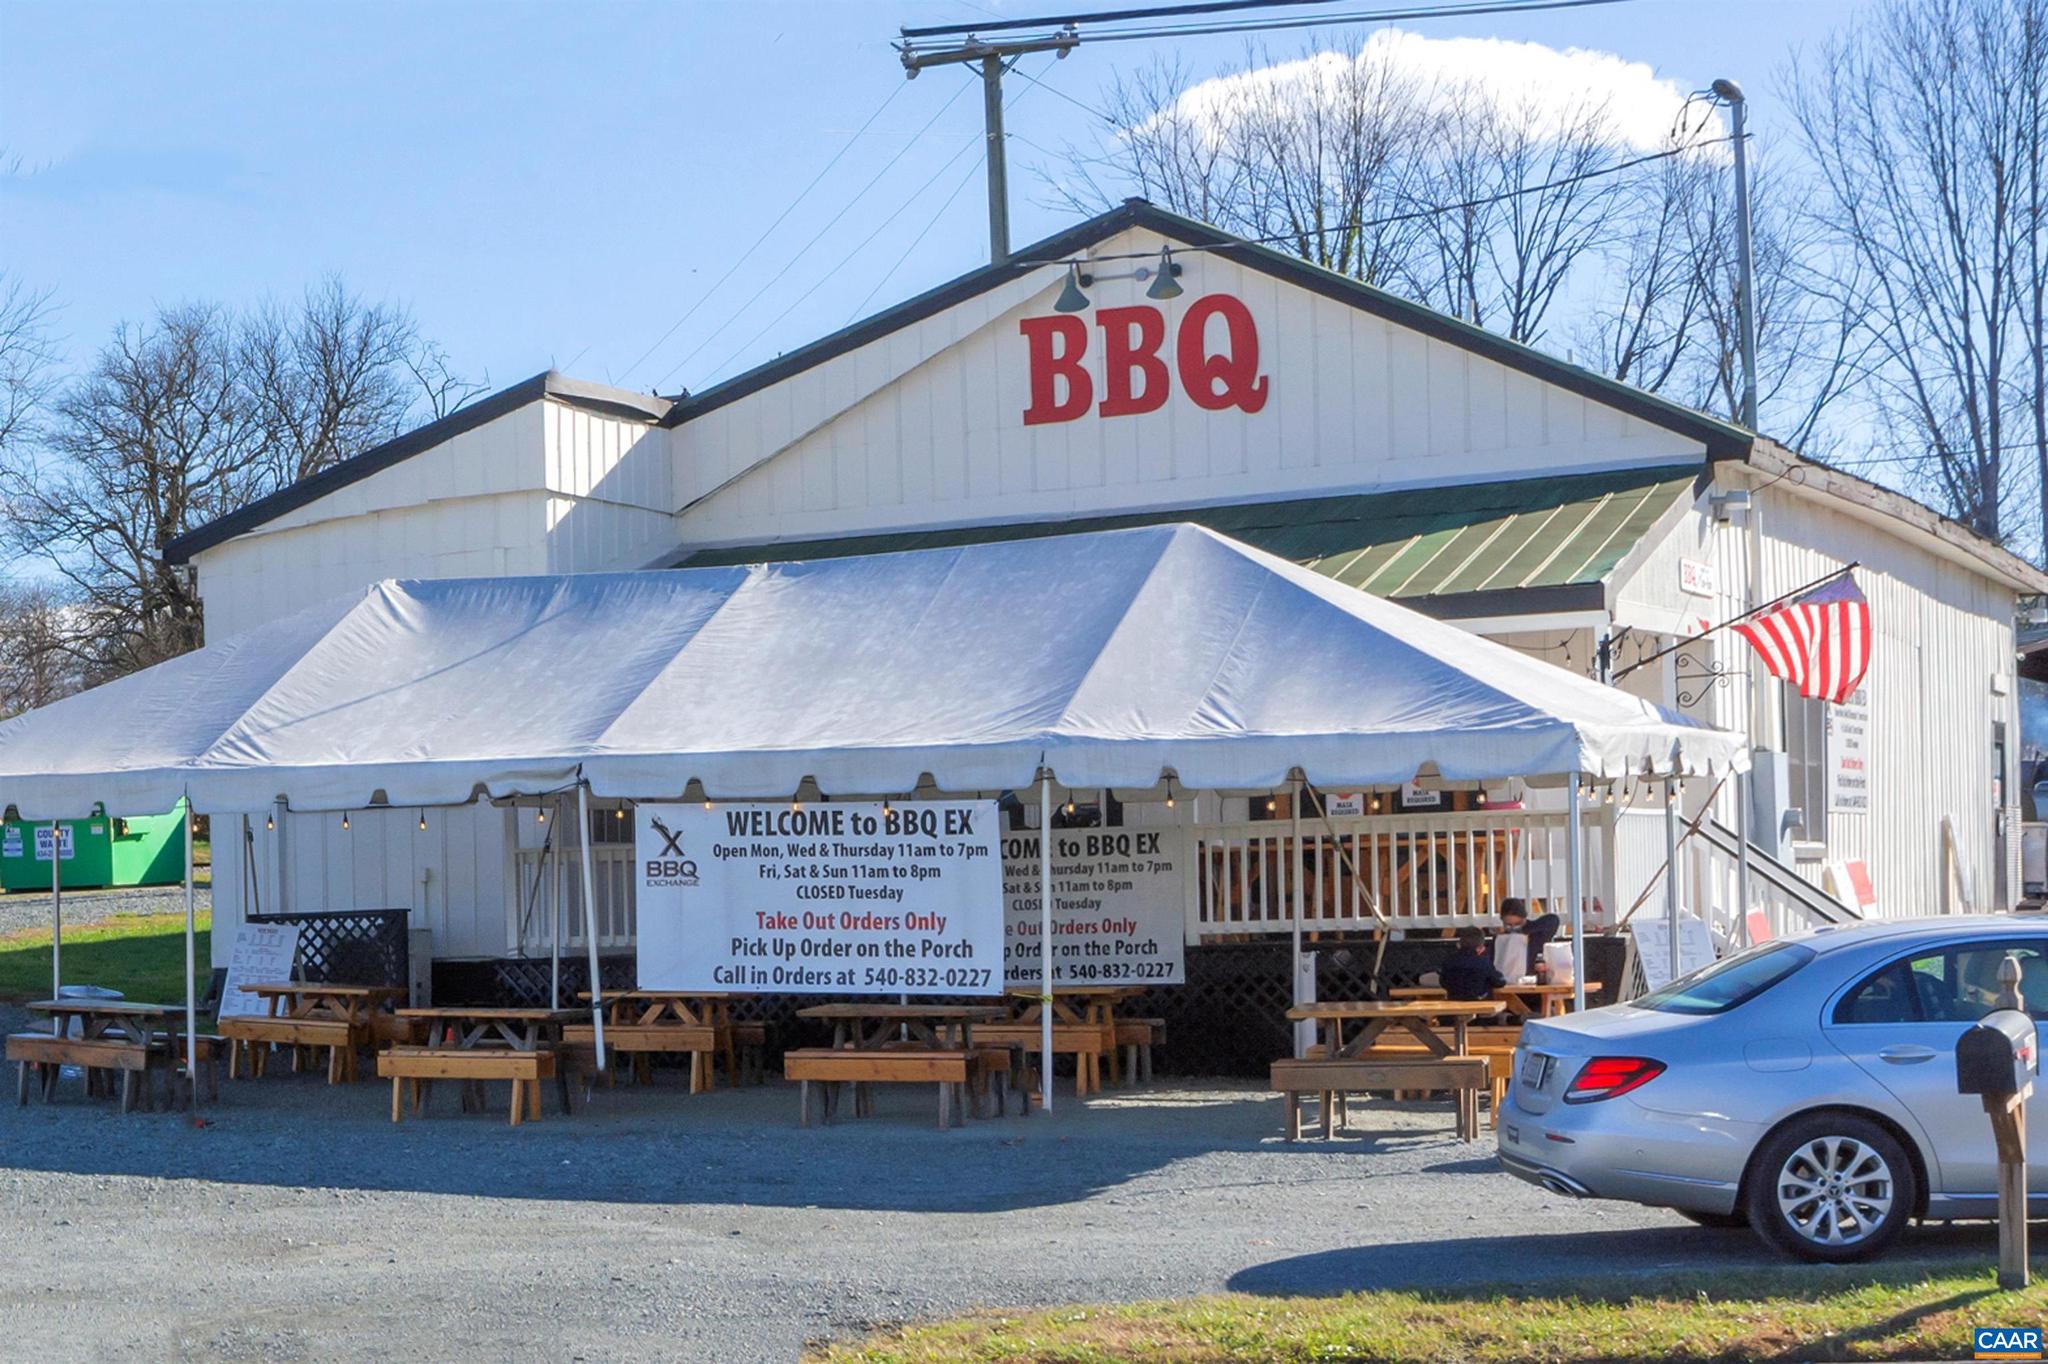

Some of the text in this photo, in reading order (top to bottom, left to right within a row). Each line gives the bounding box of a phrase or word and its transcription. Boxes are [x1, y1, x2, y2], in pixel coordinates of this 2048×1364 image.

[1019, 293, 1269, 426] BBQ
[726, 809, 974, 839] WELCOME to BBQ EX
[37, 829, 70, 839] COUTY
[713, 843, 989, 861] Open Mon, Wed & Thursday 11am to 7pm
[1058, 837, 1081, 858] to
[1086, 834, 1131, 858] BBQ
[1136, 832, 1161, 855] EX
[646, 860, 700, 880] BBQ
[759, 864, 941, 881] Fri, Sat & Sun 11am to 8pm
[1005, 860, 1173, 877] Wed & hursday 11am to 7pm
[646, 879, 700, 887] EXCHANGE
[1003, 882, 1021, 894] Sat
[1023, 881, 1032, 893] &
[1059, 881, 1090, 893] 11am
[1093, 880, 1105, 891] to
[1107, 879, 1133, 894] 8pm
[796, 885, 904, 903] CLOSED Tuesday
[1055, 897, 1102, 911] Tuesday
[756, 911, 947, 936] Take Out Orders Only
[1102, 917, 1137, 936] Only
[731, 937, 973, 961] Pick Up Order on the Porch
[1014, 942, 1058, 958] Ordr
[1061, 945, 1080, 957] on
[1085, 940, 1110, 956] the
[1115, 939, 1158, 955] Porch
[713, 965, 992, 987] Call in Orders at 540-832-0227
[1003, 964, 1043, 980] rders
[1069, 962, 1174, 979] 540-832-0227
